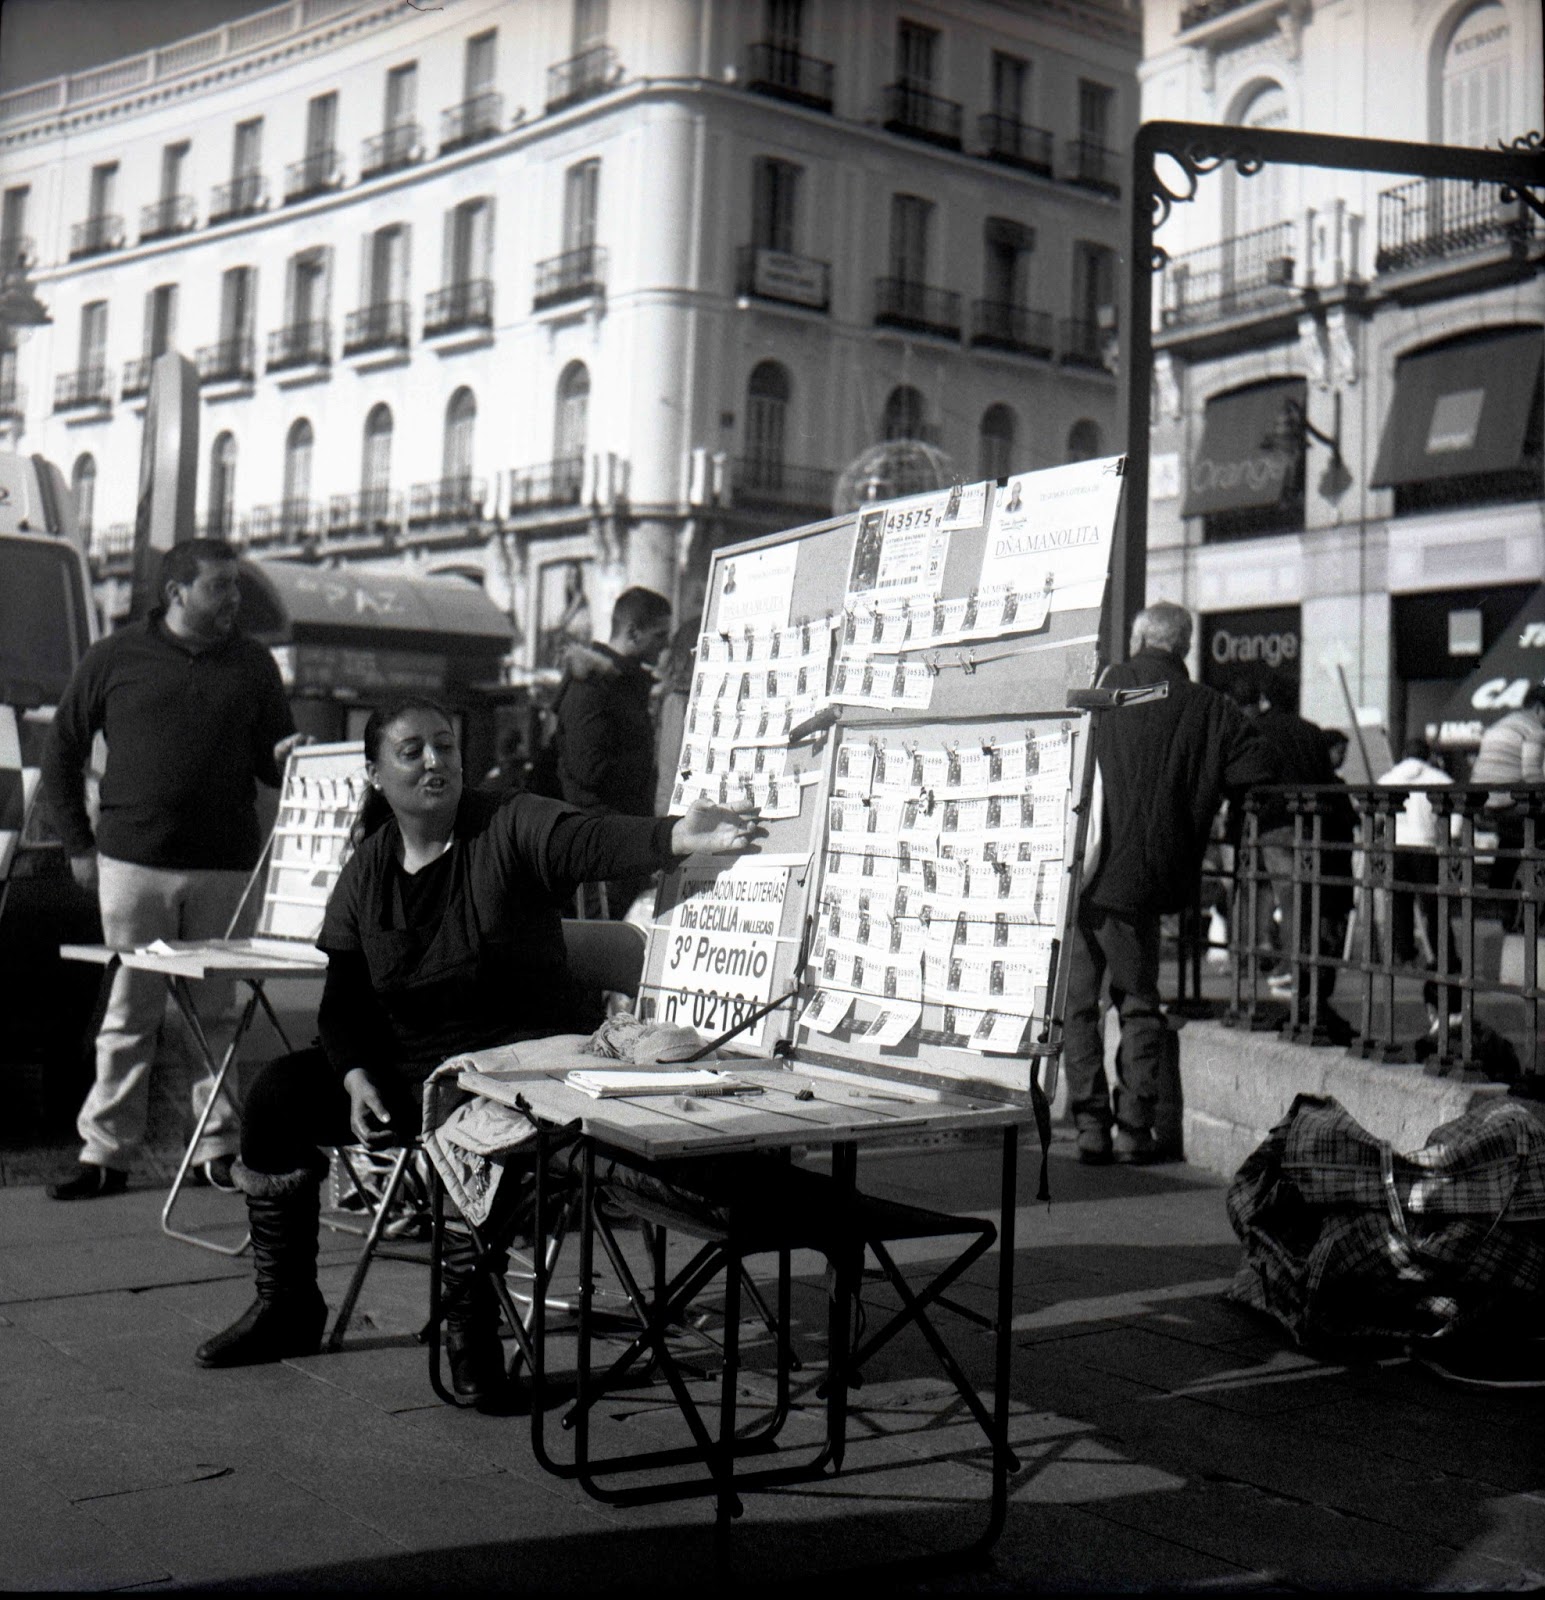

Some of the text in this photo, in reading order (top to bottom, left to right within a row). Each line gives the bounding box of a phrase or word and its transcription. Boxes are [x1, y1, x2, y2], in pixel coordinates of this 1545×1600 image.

[887, 507, 933, 530] 43575
[1211, 630, 1298, 668] Orange
[735, 880, 746, 902] DE
[680, 903, 698, 930] Dña
[699, 903, 739, 933] CECILIA
[692, 936, 769, 979] Premio
